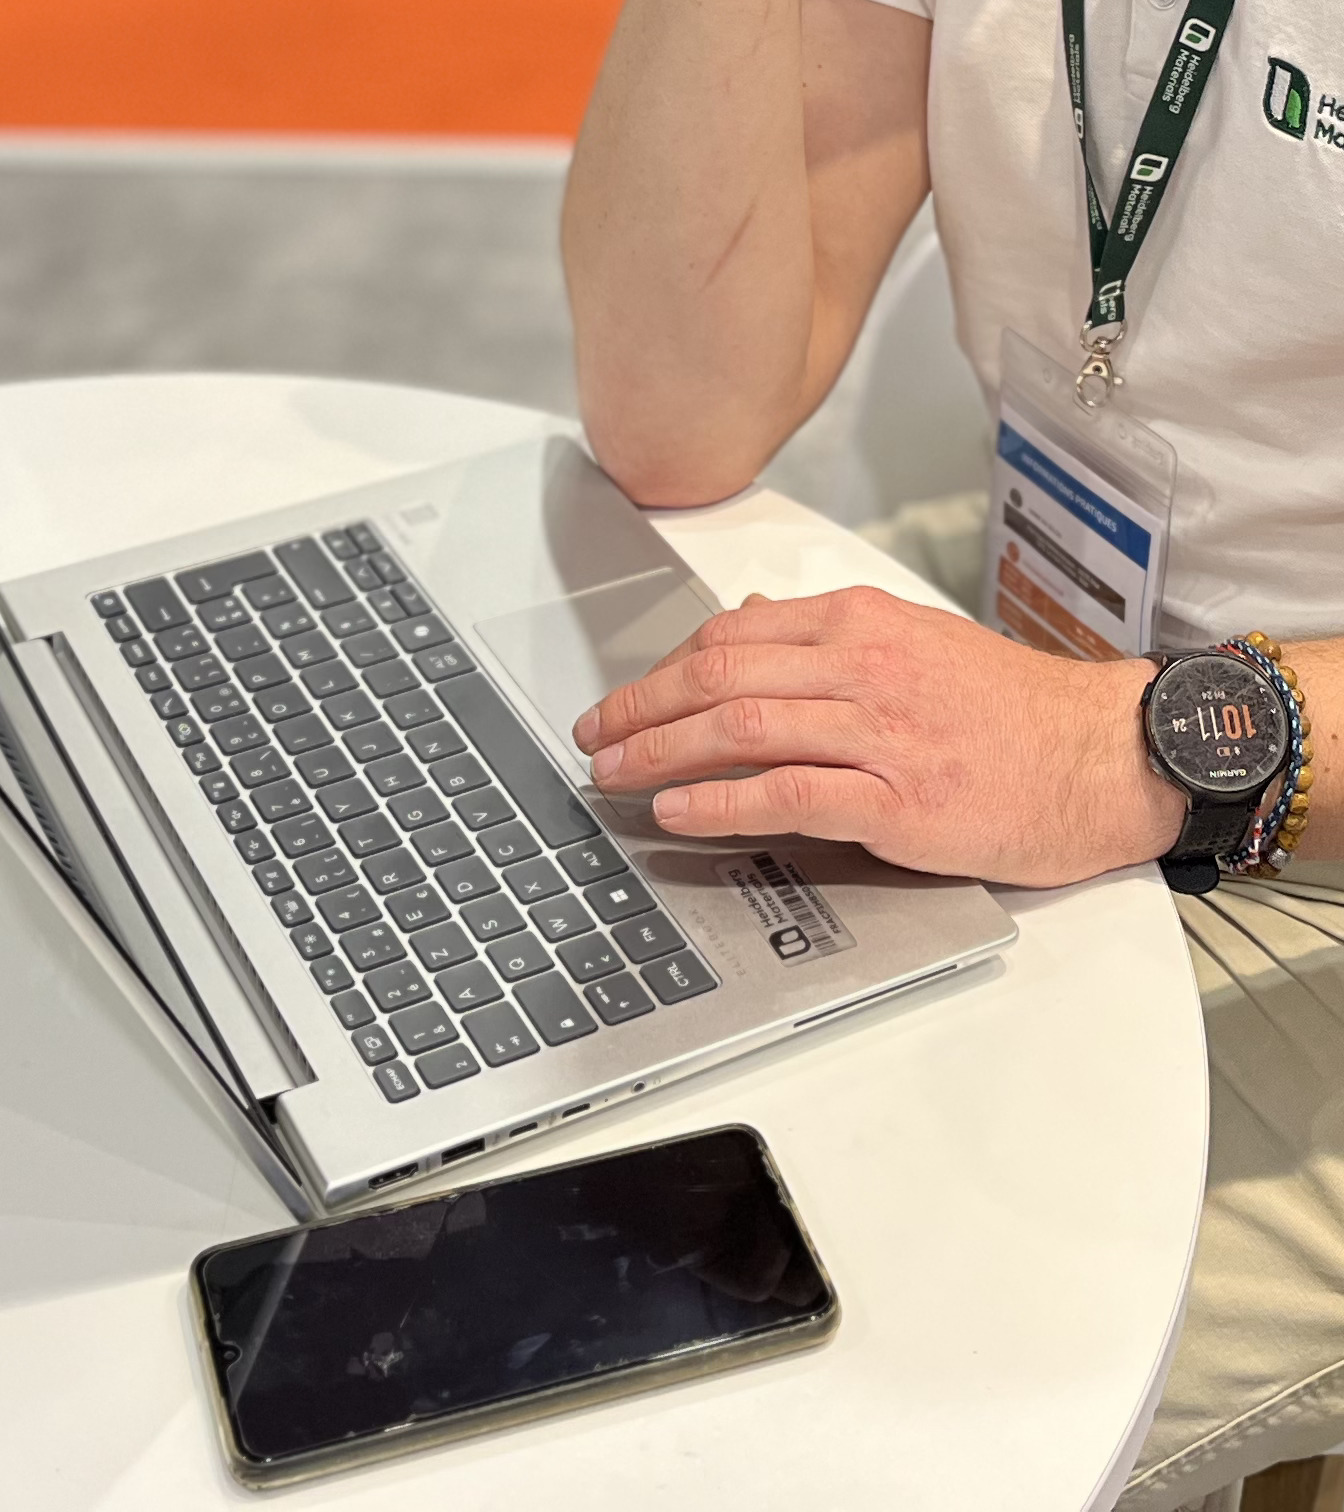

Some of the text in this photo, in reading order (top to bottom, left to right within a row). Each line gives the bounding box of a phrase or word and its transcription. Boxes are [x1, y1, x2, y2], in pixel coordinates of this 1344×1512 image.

[1162, 48, 1190, 102] Materials
[1168, 54, 1201, 114] Heidelberg
[1118, 184, 1142, 234] Materials
[1124, 186, 1154, 242] Heidelberg
[1075, 494, 1118, 532] PRATIQUES
[297, 650, 311, 660] M
[251, 674, 266, 682] P
[321, 680, 334, 689] L
[271, 703, 286, 713] O
[340, 711, 354, 720] K
[1172, 718, 1187, 732] 24
[229, 736, 242, 744] 9
[425, 742, 440, 753] N
[250, 769, 262, 777] 8
[313, 768, 328, 777] U
[1209, 768, 1246, 778] GARMIN
[384, 775, 399, 786] H
[449, 776, 465, 786] B
[335, 804, 349, 812] Y
[407, 810, 422, 820] G
[472, 812, 487, 822] V
[292, 837, 305, 845] 6
[357, 838, 373, 847] T
[430, 847, 447, 856] F
[498, 844, 514, 855] C
[581, 851, 600, 866] ALT
[314, 874, 328, 882] 5
[382, 872, 398, 884] R
[456, 881, 473, 892] D
[524, 881, 541, 893] X
[728, 868, 774, 928] Heidelberg
[747, 873, 788, 924] Materials
[405, 909, 423, 921] E
[481, 919, 497, 929] S
[548, 918, 567, 932] W
[639, 926, 655, 941] FN
[361, 949, 375, 958] 3
[430, 947, 448, 960] Z
[508, 956, 524, 970] Q
[666, 961, 689, 986] CTRL
[387, 989, 401, 998] 2
[458, 987, 475, 998] A
